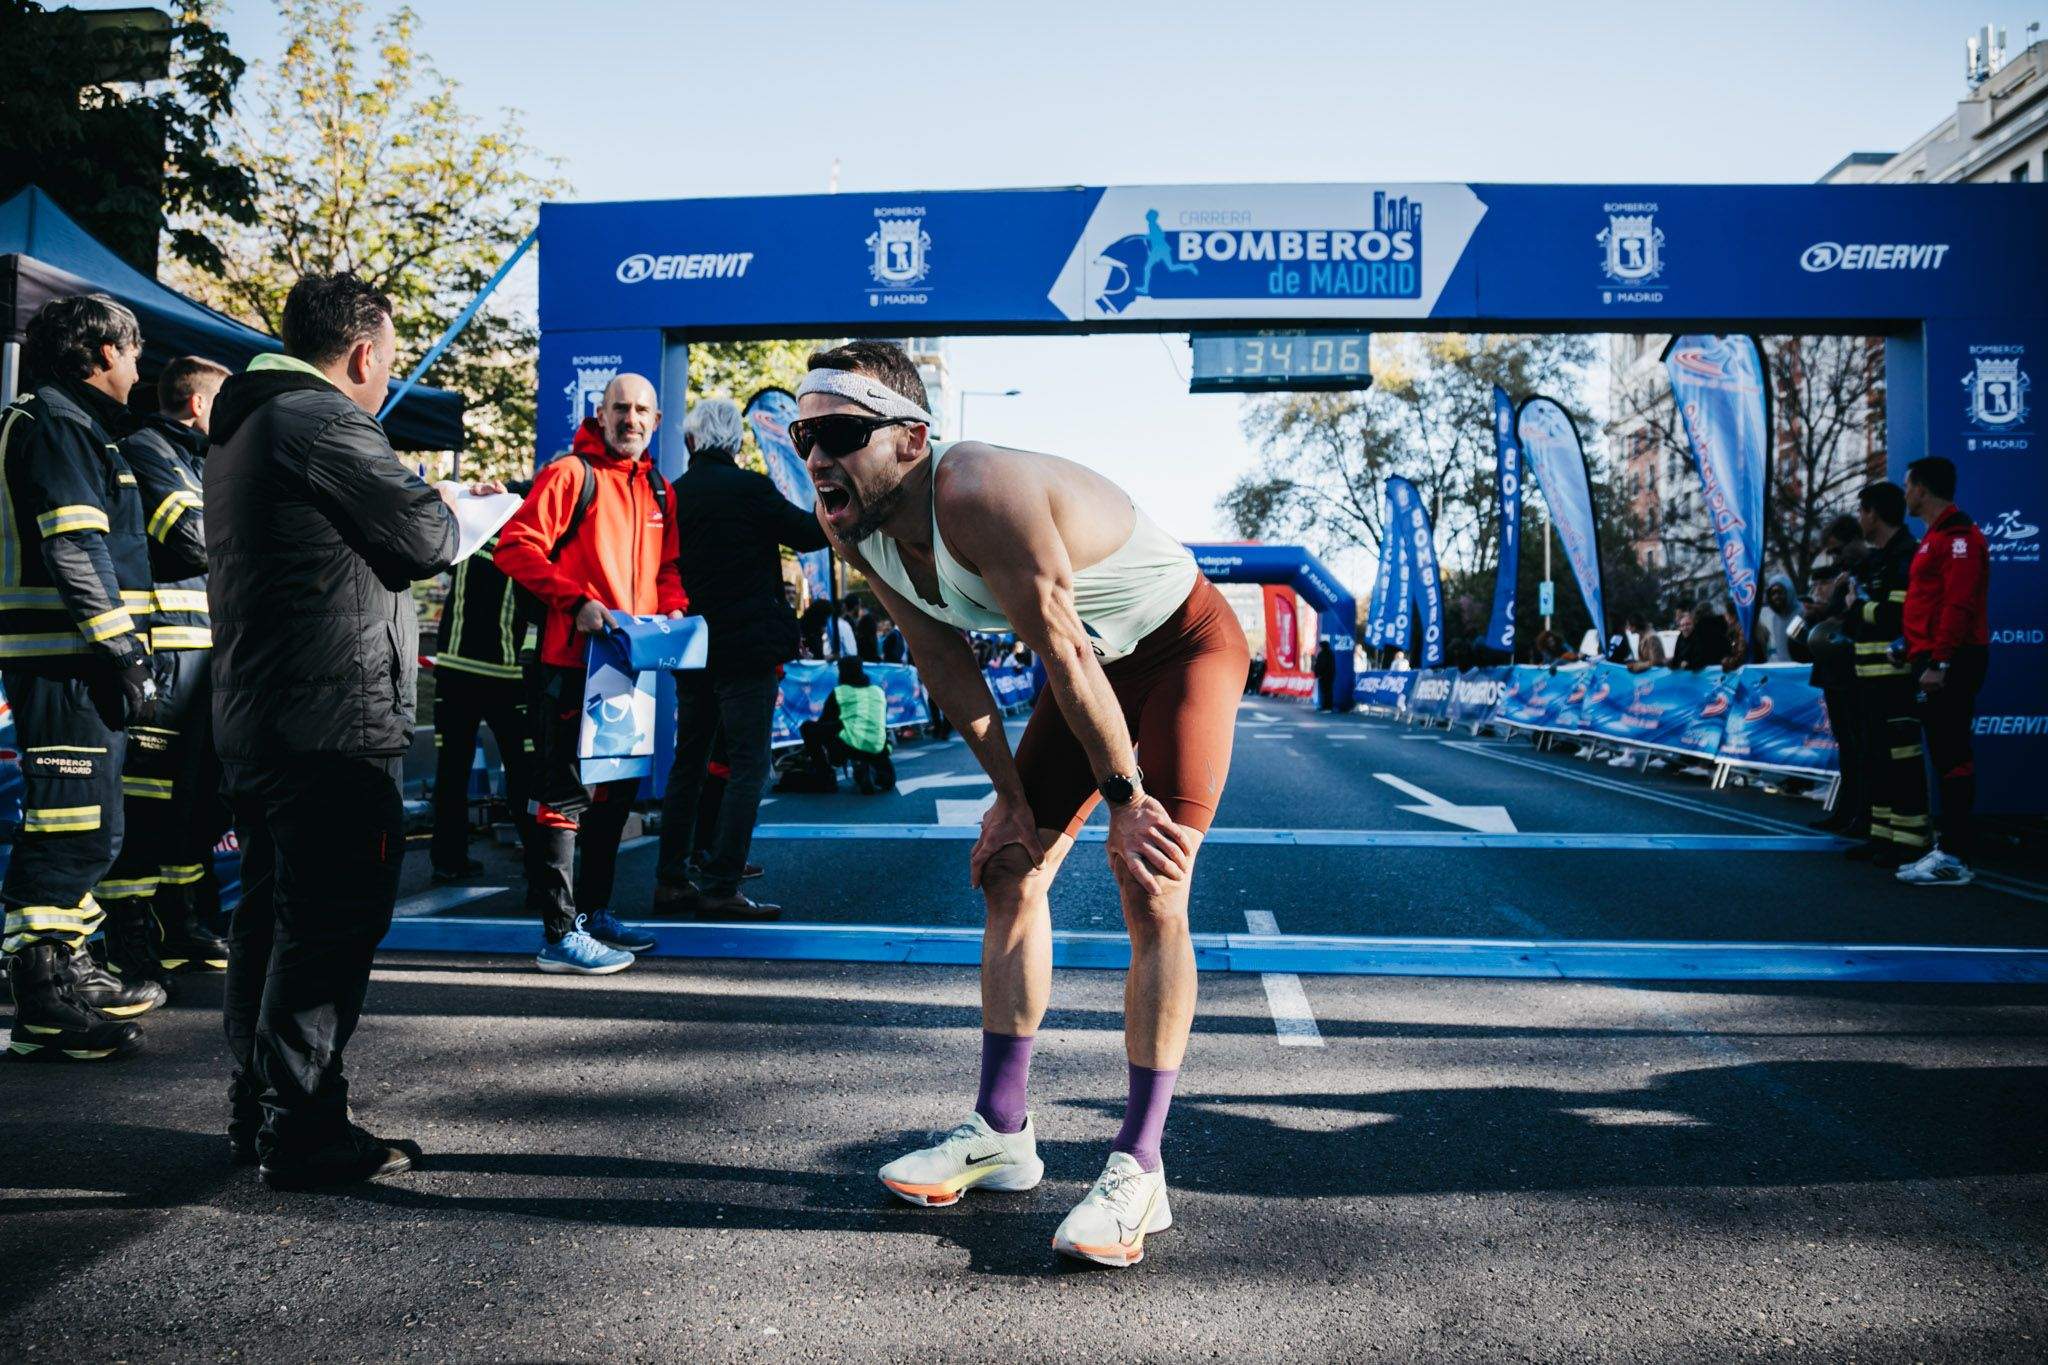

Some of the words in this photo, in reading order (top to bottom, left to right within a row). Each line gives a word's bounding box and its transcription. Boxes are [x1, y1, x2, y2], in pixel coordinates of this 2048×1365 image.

[873, 206, 927, 217] BOMBEROS
[1603, 202, 1659, 213] BOMBEROS
[1179, 209, 1252, 226] CARRERA
[1178, 230, 1415, 263] BOMBEROS
[1840, 244, 1950, 270] ENERVIT
[652, 252, 754, 281] ENERVIT
[1269, 263, 1301, 294] de
[1310, 263, 1415, 295] MADRID
[883, 293, 928, 305] MADRID
[1617, 292, 1664, 303] MADRID
[1969, 344, 2024, 355] BOMBEROS
[572, 355, 623, 366] BOMBEROS
[1981, 439, 2028, 450] MADRID
[1990, 629, 2044, 644] ADRID
[36, 757, 92, 767] BOMBEROS
[59, 766, 92, 775] MADRID
